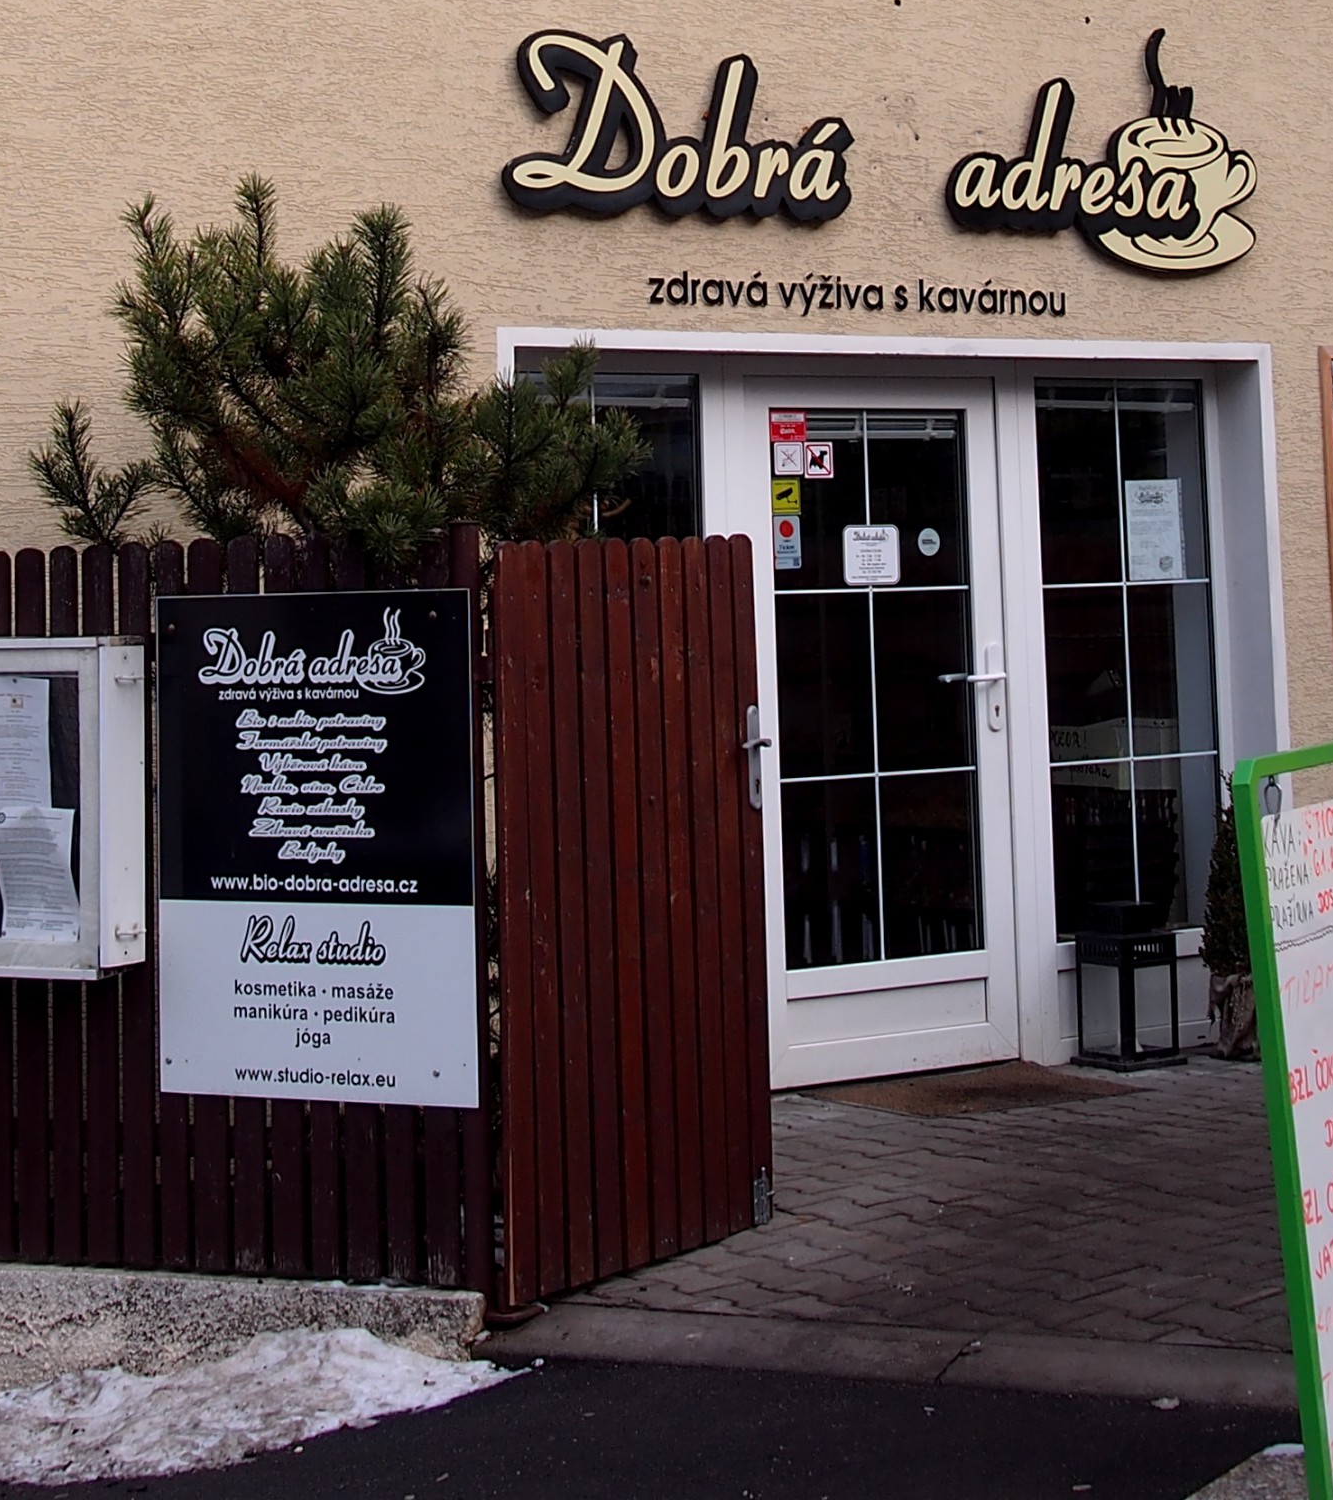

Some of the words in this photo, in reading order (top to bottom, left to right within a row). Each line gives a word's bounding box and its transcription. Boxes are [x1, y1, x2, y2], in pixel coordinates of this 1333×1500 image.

[505, 31, 853, 212] Dobrá
[951, 77, 1197, 228] adresa
[649, 272, 768, 307] zdravá
[777, 274, 887, 314] výživa
[894, 284, 909, 311] s
[917, 277, 1066, 317] kavárnou
[199, 628, 305, 684] Dobrá
[308, 629, 403, 683] adresa
[218, 687, 256, 700] zdravá
[259, 686, 294, 702] výživa
[296, 690, 303, 699] s
[305, 687, 359, 700] kavárnou
[235, 709, 267, 728] Bio
[315, 713, 387, 732] potraviny
[316, 735, 388, 753] potraviny
[258, 752, 328, 775] Výběrová
[329, 753, 367, 771] káva
[338, 774, 385, 794] Cidre
[306, 797, 365, 820] zákusky
[248, 817, 312, 837] Zdravá
[311, 819, 375, 838] svačinka
[210, 874, 419, 894] www.bio-dobra-adresa.cz
[240, 915, 313, 963] Relax
[316, 920, 386, 966] studio
[234, 979, 316, 998] kosmetika
[332, 982, 394, 1000] masáže
[233, 1004, 308, 1021] manikúra
[323, 1006, 395, 1025] pedikúra
[295, 1027, 331, 1048] jóga
[235, 1066, 396, 1088] www.studio-relax.eu
[1302, 1187, 1322, 1225] ZL
